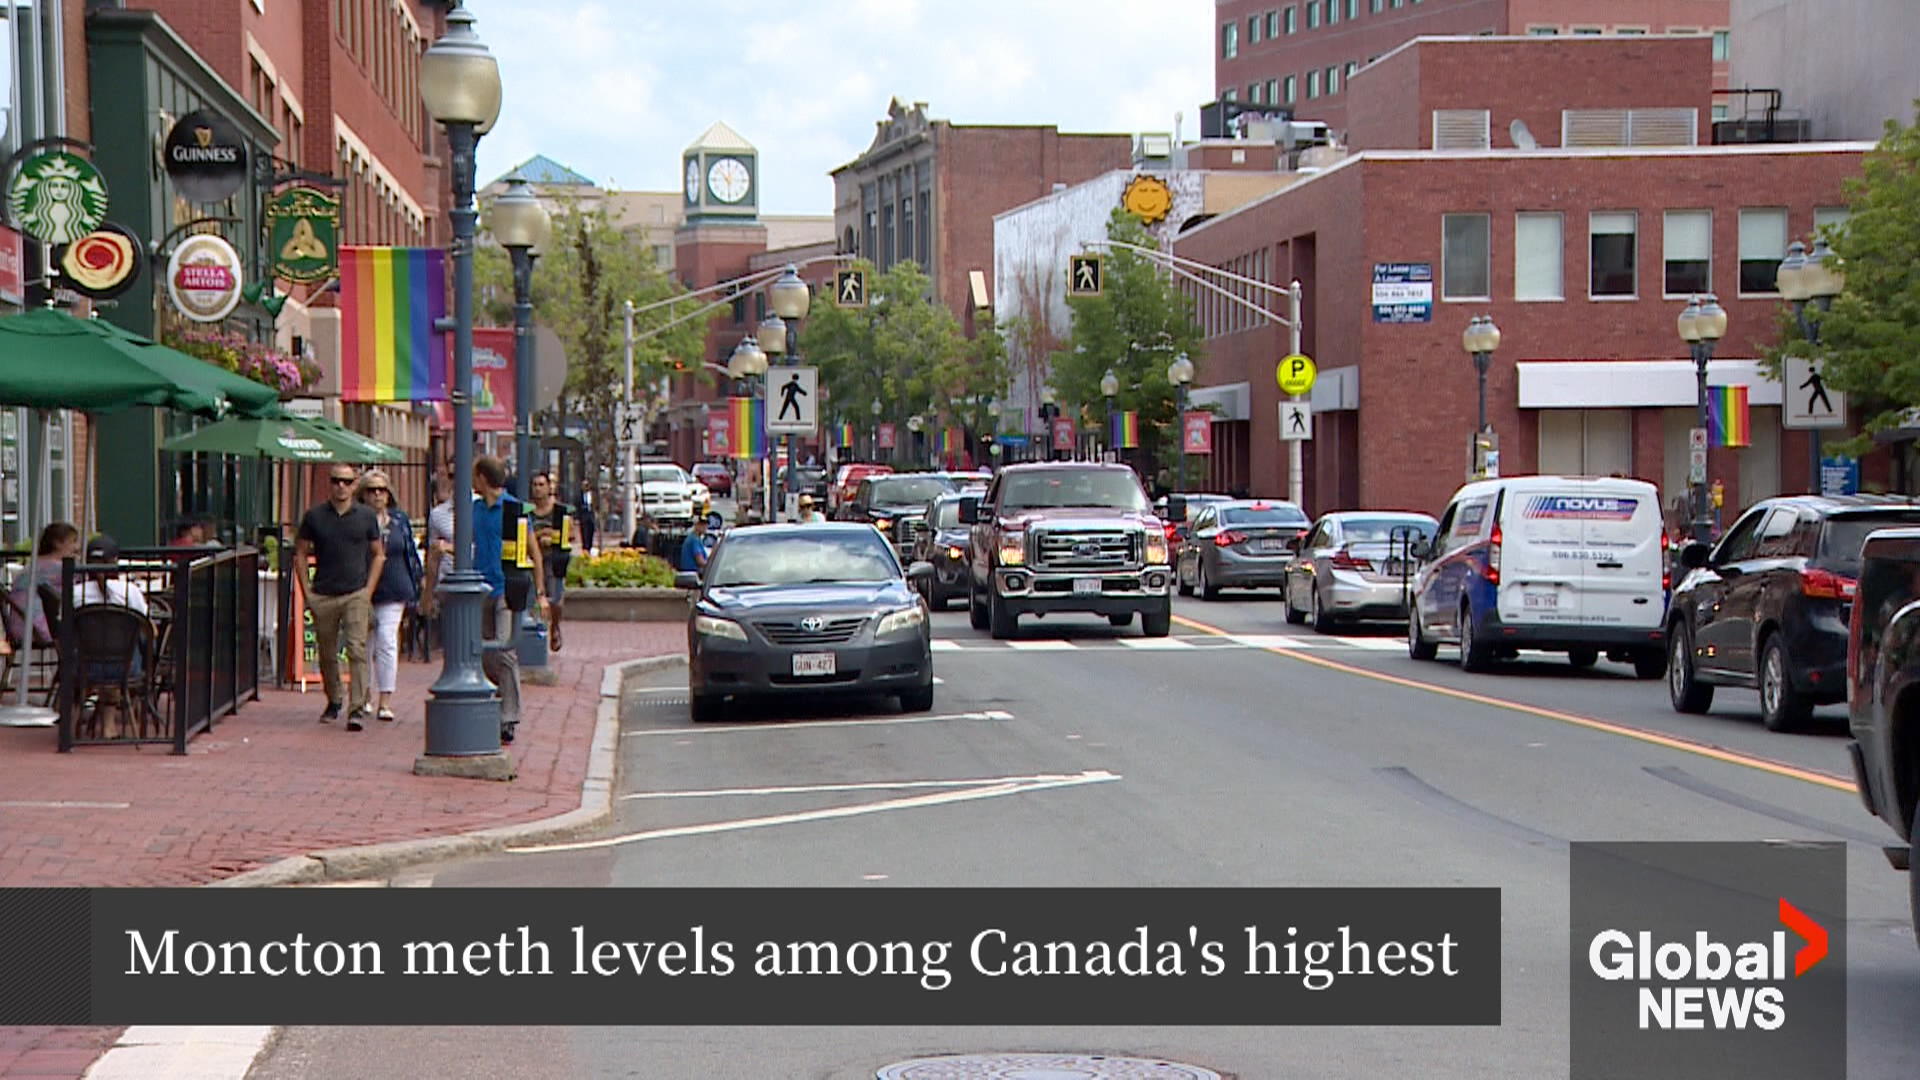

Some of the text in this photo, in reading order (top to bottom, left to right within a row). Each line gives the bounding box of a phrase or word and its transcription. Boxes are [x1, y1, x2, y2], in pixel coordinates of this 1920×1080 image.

[172, 146, 237, 162] GUINNESS
[183, 268, 225, 278] STELLA
[183, 278, 225, 288] ARTOIS
[1292, 359, 1305, 378] P
